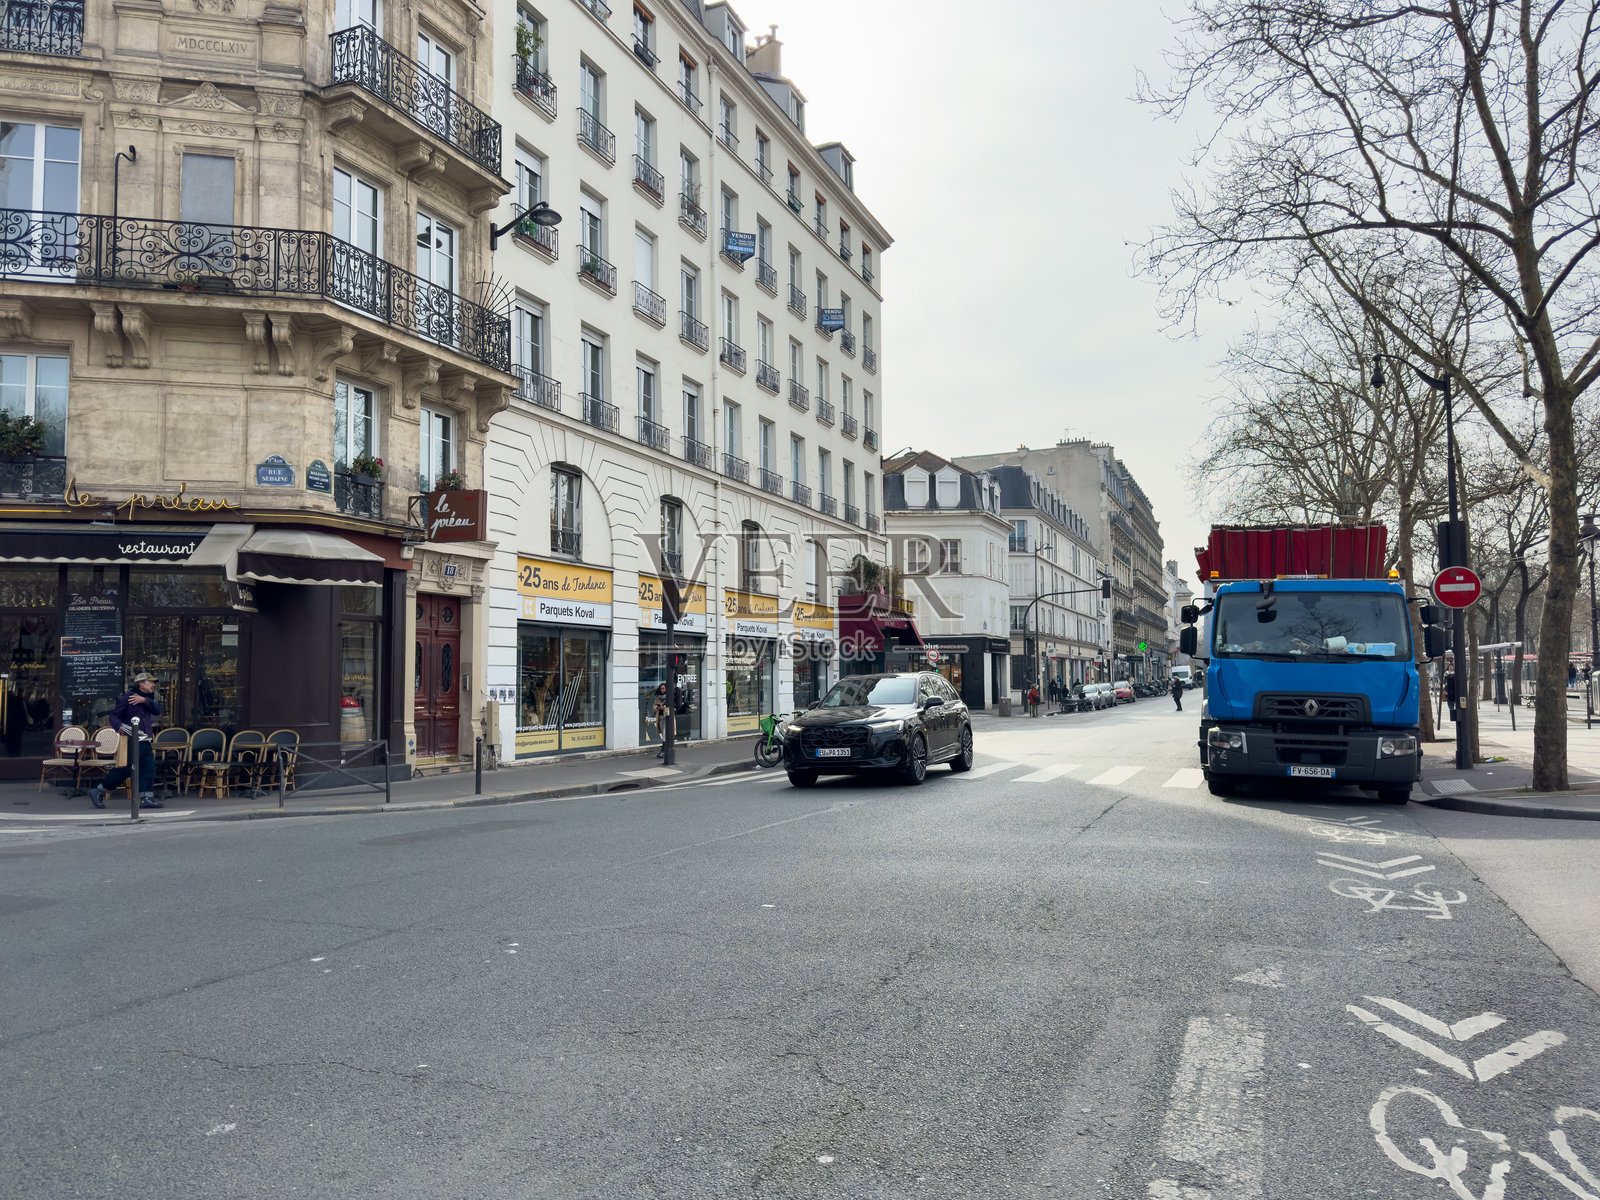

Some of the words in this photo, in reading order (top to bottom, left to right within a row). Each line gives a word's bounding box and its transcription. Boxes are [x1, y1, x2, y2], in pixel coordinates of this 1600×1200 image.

[177, 37, 248, 54] MDCCCLXIV
[65, 476, 100, 507] le
[117, 482, 240, 521] préau
[434, 494, 450, 513] le
[430, 511, 476, 539] préau
[118, 540, 196, 554] restaurant
[446, 566, 454, 575] 18
[518, 565, 542, 588] +25
[542, 579, 559, 591] ans
[561, 576, 572, 592] de
[572, 576, 606, 592] Tendance
[638, 582, 654, 602] +25
[540, 602, 574, 618] Parquets
[575, 606, 594, 618] Koval
[737, 622, 756, 634] Parquets
[756, 625, 768, 634] Koval
[1292, 766, 1330, 776] FV-656-DA
